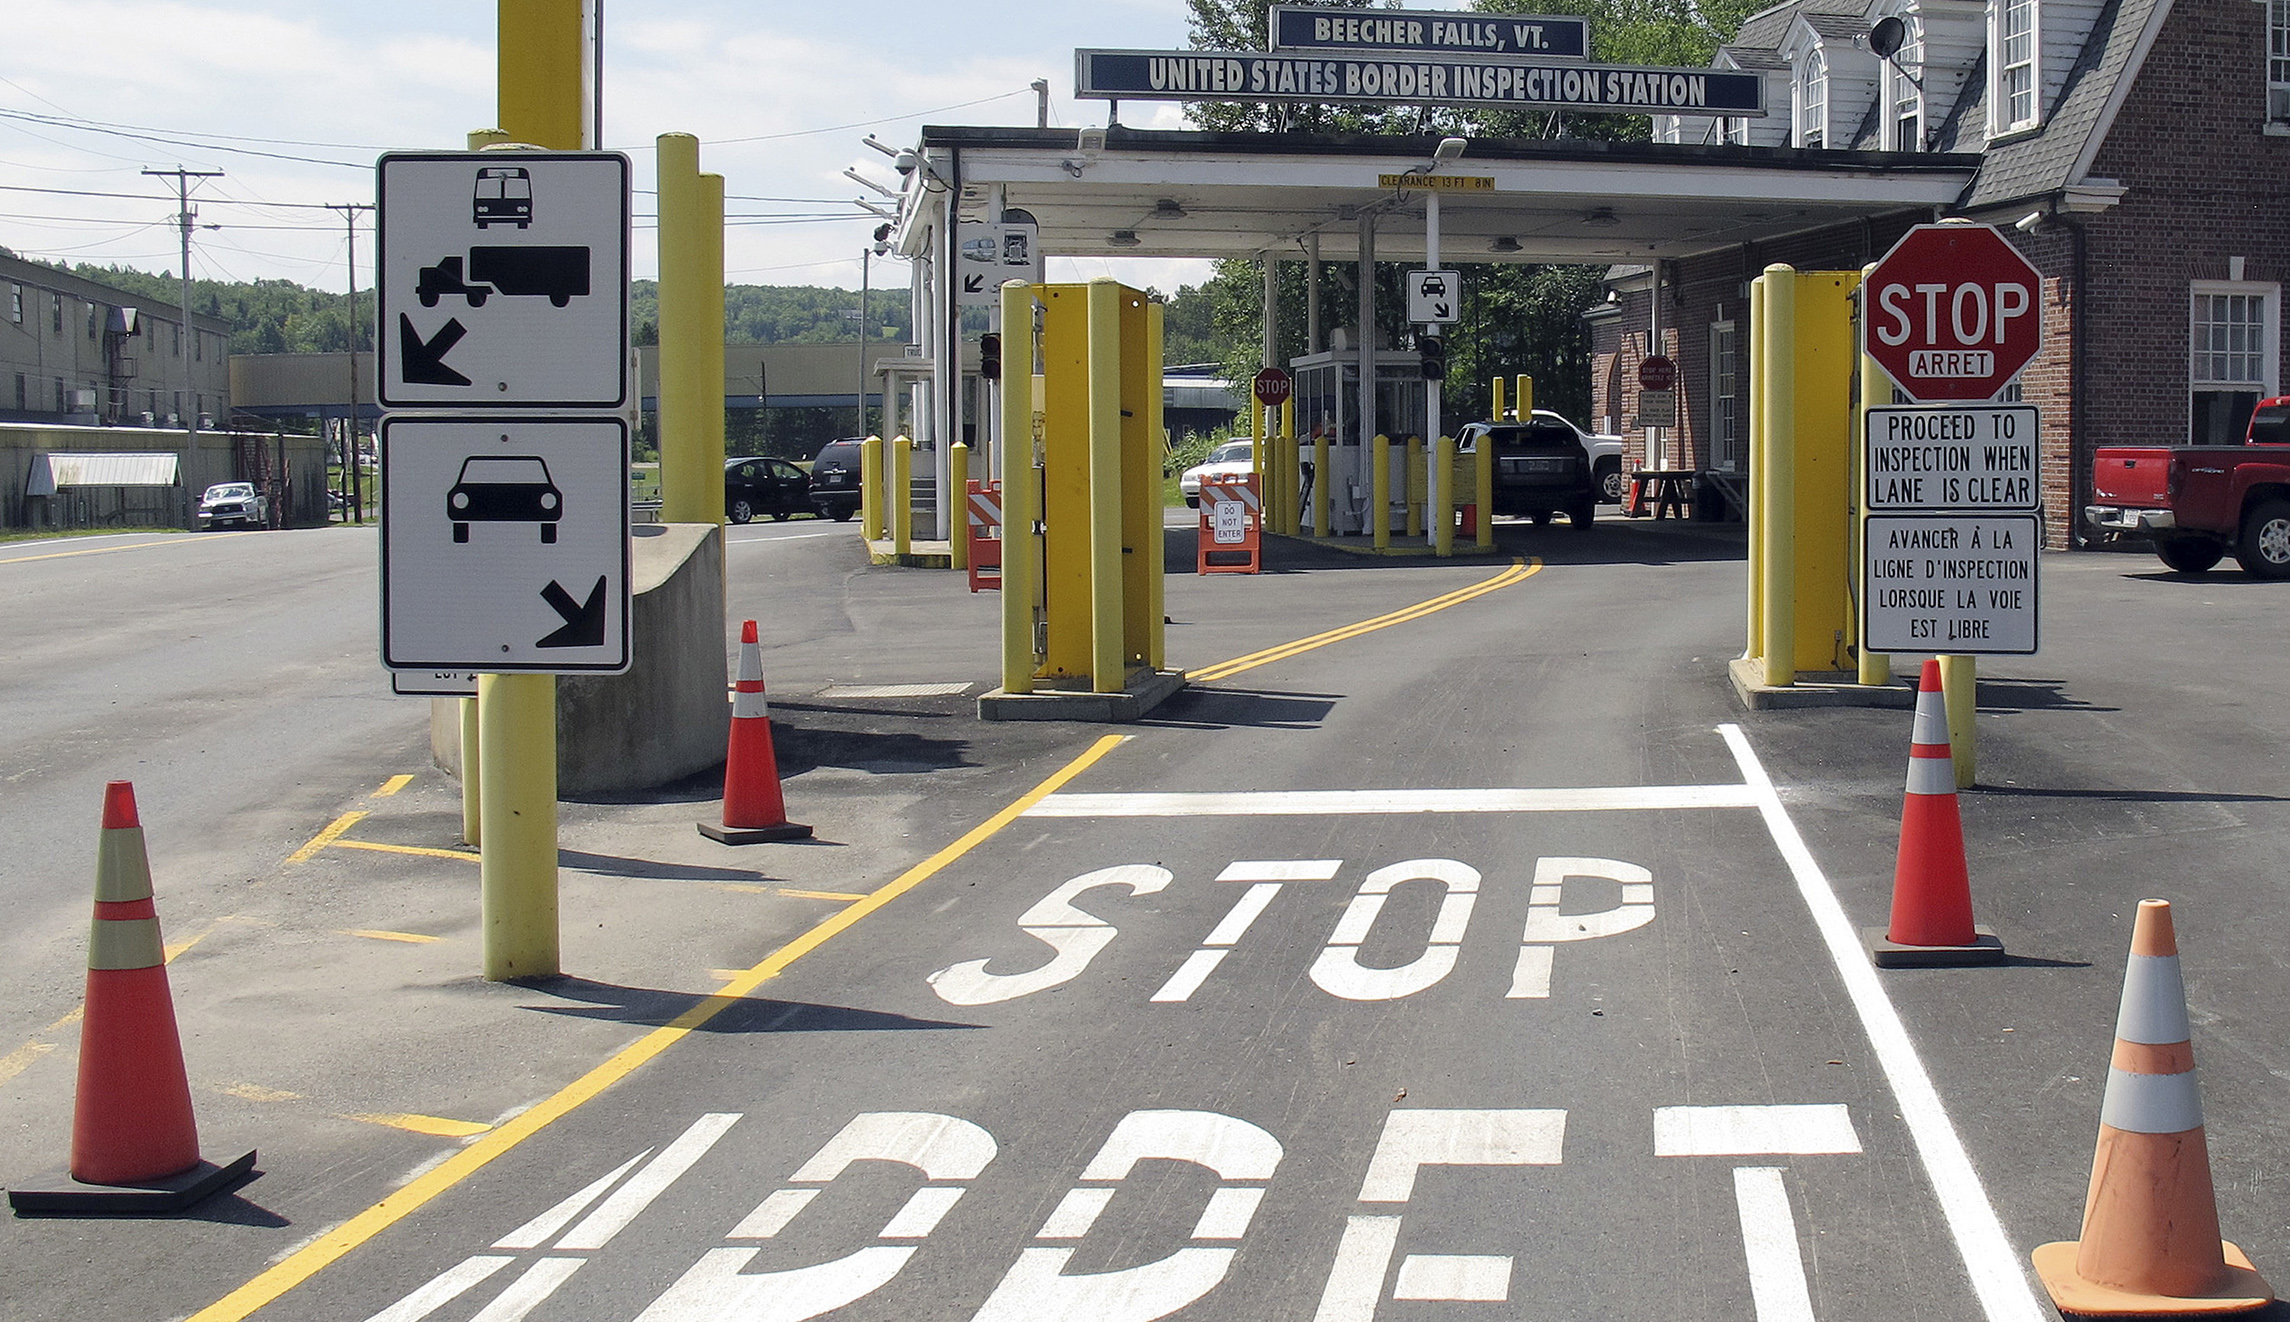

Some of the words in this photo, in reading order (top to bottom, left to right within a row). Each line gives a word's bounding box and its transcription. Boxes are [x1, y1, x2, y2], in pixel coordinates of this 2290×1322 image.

[1314, 17, 1424, 45] BEECHER
[1432, 22, 1506, 51] FALLS,
[1513, 25, 1549, 49] VT.
[1149, 57, 1244, 91] UNITED
[1251, 59, 1338, 95] STATES
[1345, 63, 1448, 97] BORDER
[1454, 66, 1600, 102] INSPECTION
[1606, 71, 1706, 106] STATION
[1442, 178, 1451, 188] 13
[1454, 178, 1465, 188] FT
[1474, 179, 1481, 188] 8
[1482, 180, 1491, 188] IN
[1877, 281, 2030, 346] STOP
[1915, 353, 1988, 375] ARRET
[1256, 379, 1289, 395] STOP
[1888, 415, 1975, 441] PROCEED
[1992, 414, 2015, 439] TO
[1875, 446, 1970, 472] INSPECTION
[1983, 446, 2030, 471] WHEN
[1875, 478, 1923, 503] LANE
[1943, 477, 1960, 502] IS
[1968, 477, 2029, 503] CLEAR
[1224, 506, 1235, 515] DO
[1222, 518, 1236, 526] NOT
[1218, 529, 1241, 538] ENTER
[1889, 529, 1959, 549] AVANCER
[1971, 525, 1981, 549] À
[1993, 530, 2013, 549] LA
[1874, 559, 1914, 579] LIGNE
[1926, 559, 2028, 579] D'INSPECTION
[1880, 589, 1945, 608] LORSQUE
[1957, 590, 1977, 608] LA
[1989, 590, 2022, 609] VOIE
[1911, 619, 1937, 638] EST
[1949, 619, 1990, 639] LIBRE
[926, 857, 1656, 1006] STOP
